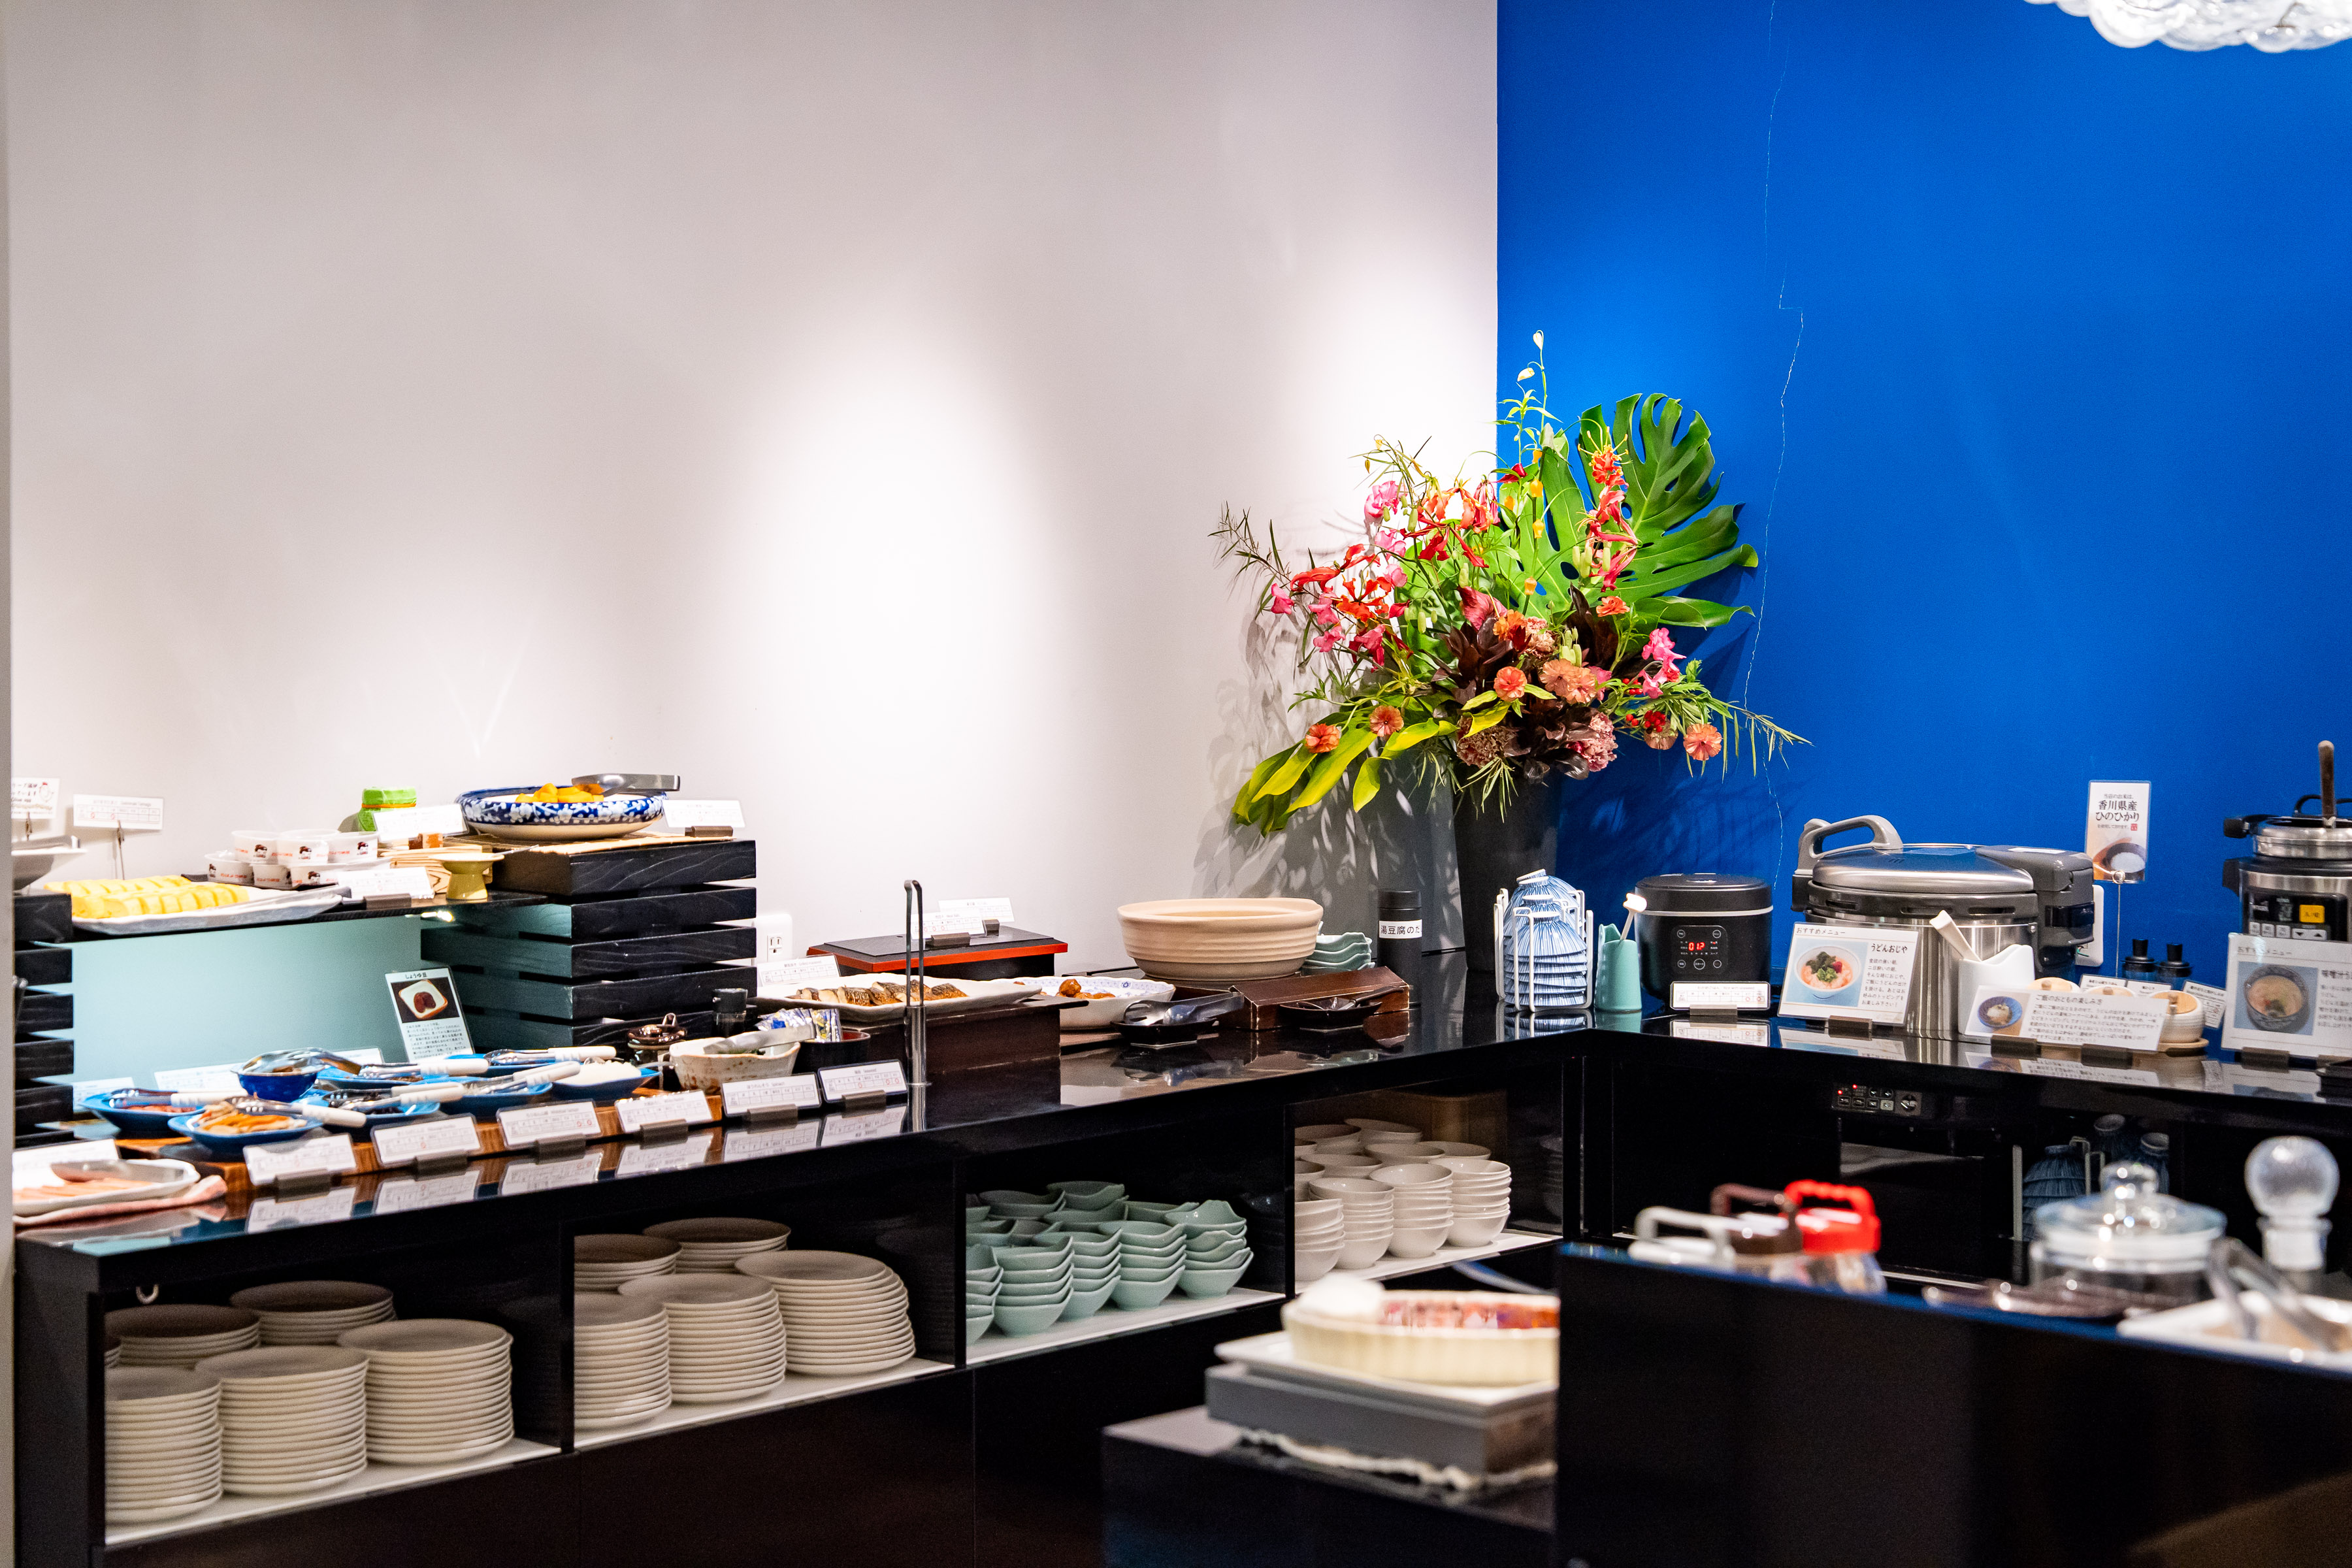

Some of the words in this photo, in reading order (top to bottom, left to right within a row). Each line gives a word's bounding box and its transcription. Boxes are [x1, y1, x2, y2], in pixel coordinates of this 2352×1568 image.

[2099, 800, 2137, 811] 香川県産
[2095, 811, 2139, 822] ひのひかり
[1380, 925, 1422, 935] 湯豆腐のだ
[1871, 943, 1908, 954] うどんおじや
[2036, 994, 2102, 1005] ご飯のおともの楽しみ方
